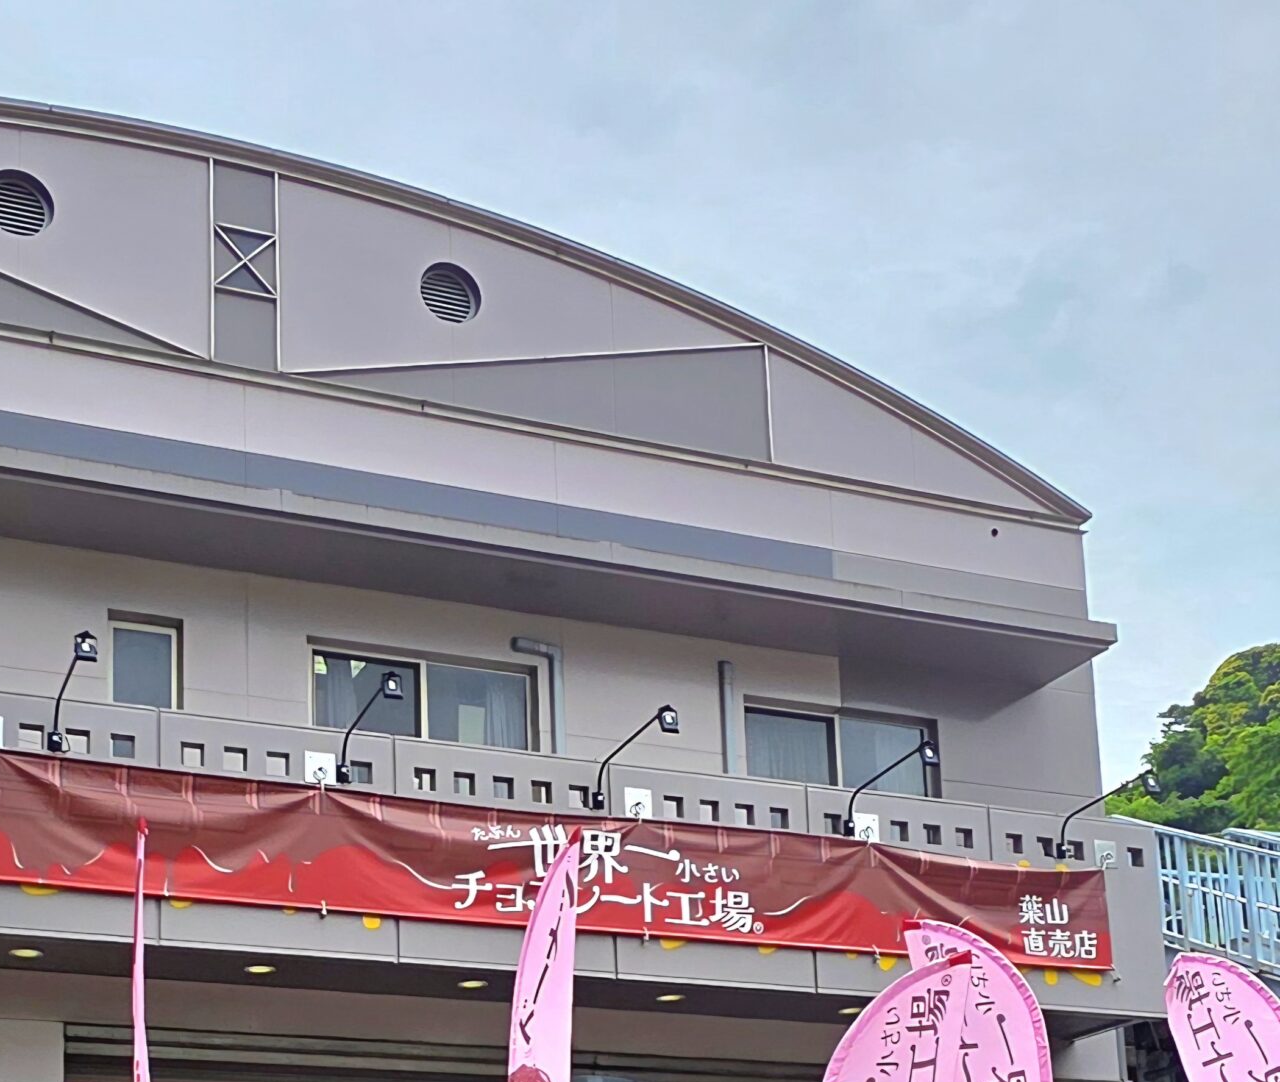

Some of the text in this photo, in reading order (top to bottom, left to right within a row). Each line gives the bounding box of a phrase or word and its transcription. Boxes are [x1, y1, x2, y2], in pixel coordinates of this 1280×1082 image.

[471, 824, 521, 842] たぶん
[675, 858, 740, 884] 小さい
[451, 868, 755, 934] チョレート工場
[1018, 894, 1069, 925] 葉山
[1020, 927, 1098, 959] 直売店
